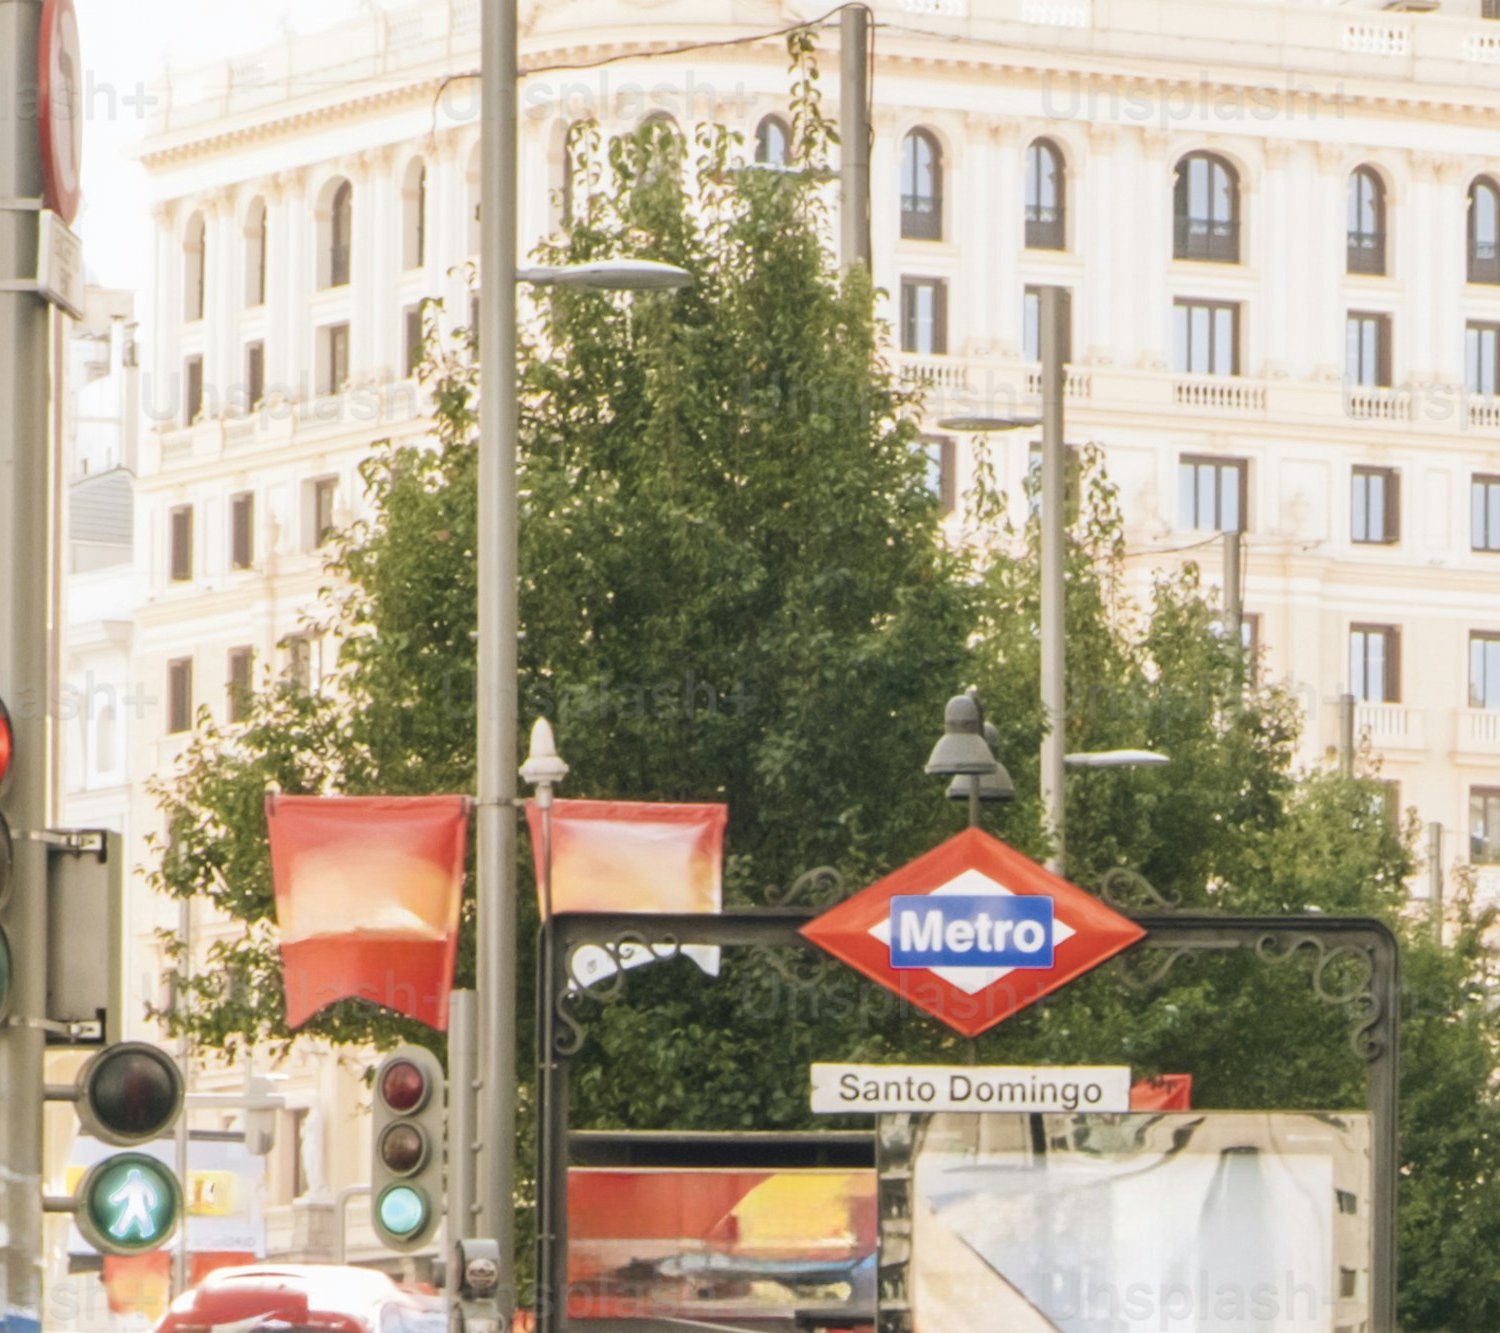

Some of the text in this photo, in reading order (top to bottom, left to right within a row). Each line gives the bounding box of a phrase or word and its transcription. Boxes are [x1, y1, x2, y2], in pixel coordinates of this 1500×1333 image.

[900, 909, 1045, 953] Metro
[838, 1073, 1103, 1110] Santo Domingo
